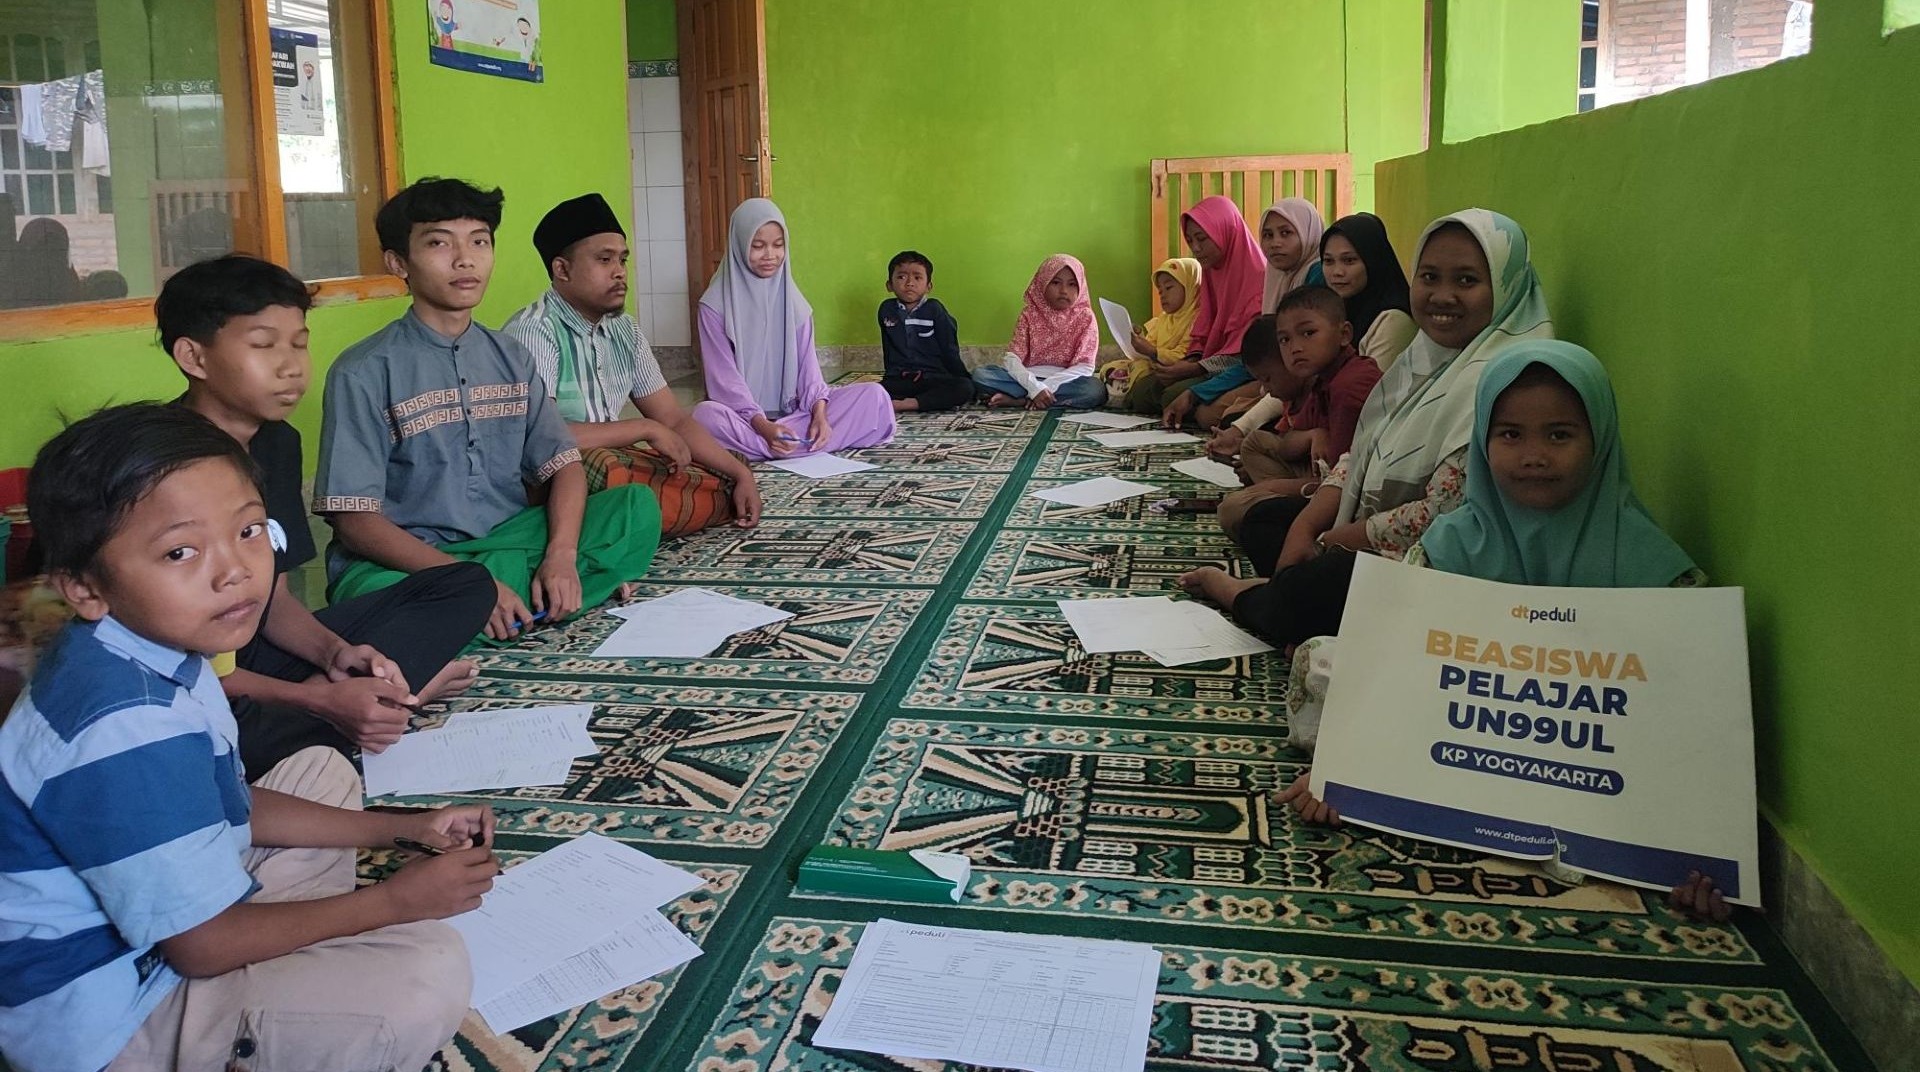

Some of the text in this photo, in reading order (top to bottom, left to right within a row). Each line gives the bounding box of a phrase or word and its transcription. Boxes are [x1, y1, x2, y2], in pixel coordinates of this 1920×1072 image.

[1511, 605, 1576, 623] dtpeduli
[1425, 628, 1648, 682] BEASISWA
[1439, 664, 1628, 716] PELAJAR
[1448, 701, 1615, 753] UN99UL
[1441, 747, 1613, 790] KP YOGYAKARTA
[1474, 826, 1568, 852] www.dtpeduli.org
[903, 929, 946, 937] peduli
